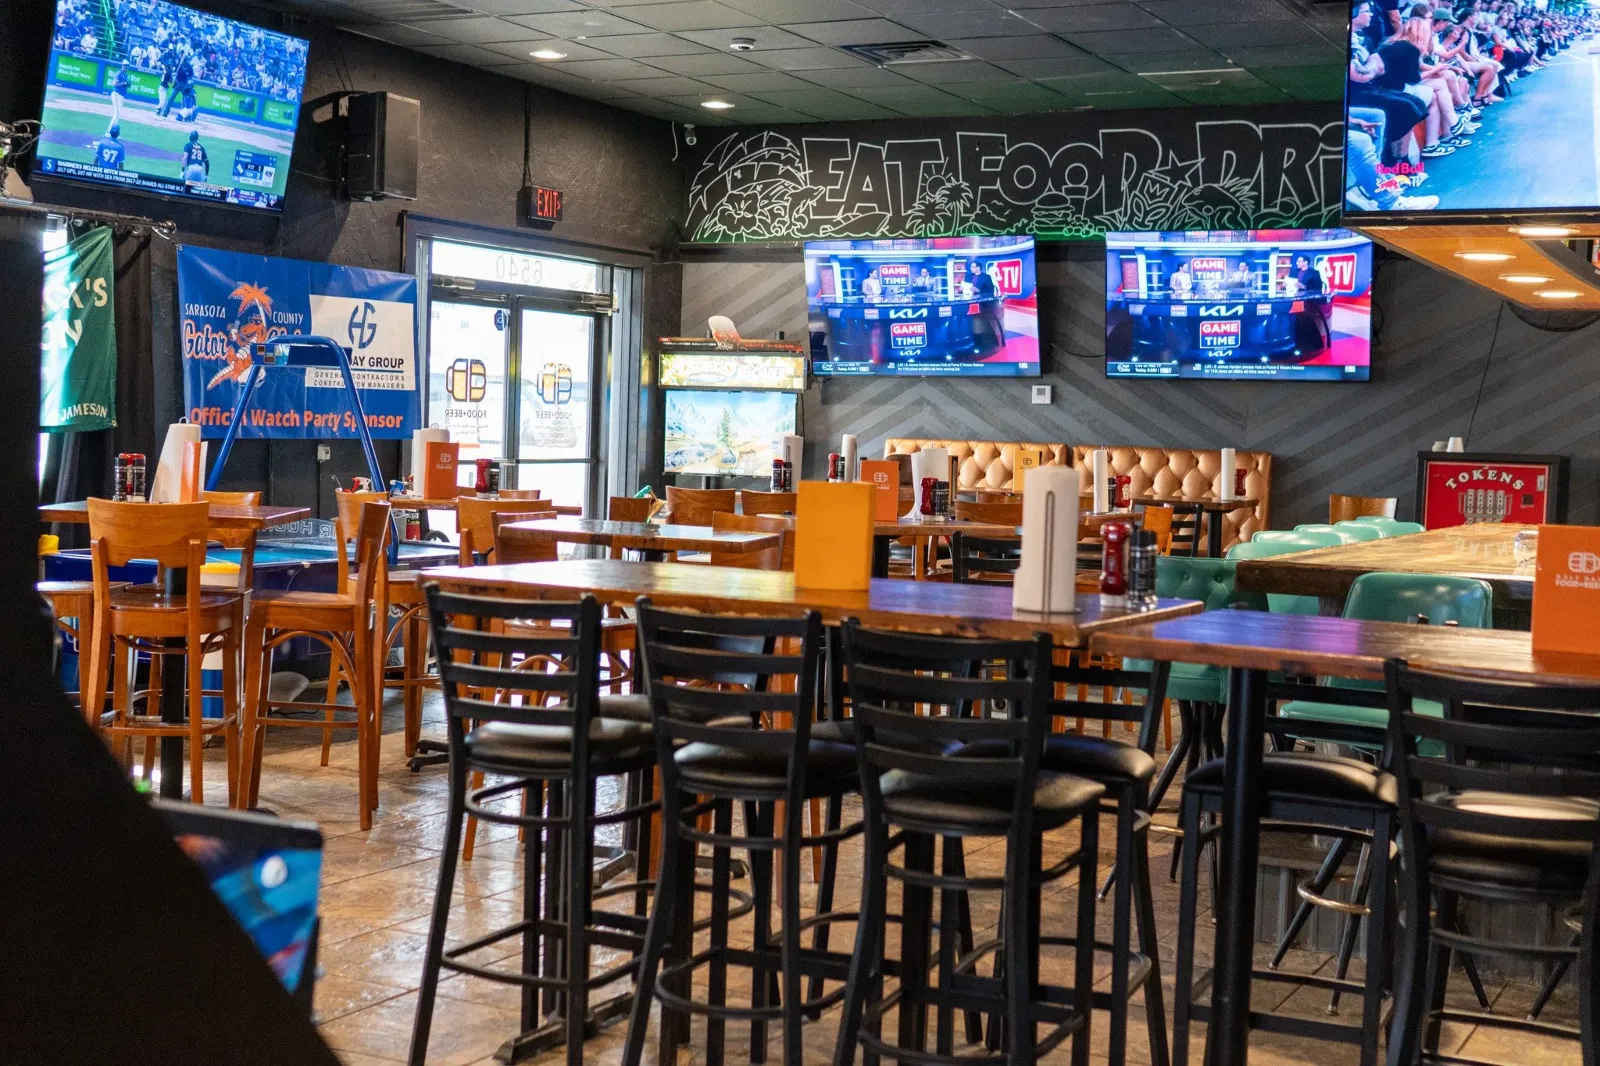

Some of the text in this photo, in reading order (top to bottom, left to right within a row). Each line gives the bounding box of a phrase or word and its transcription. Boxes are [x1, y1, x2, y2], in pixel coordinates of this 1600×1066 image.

[103, 149, 118, 164] 97
[802, 138, 944, 218] EAT
[956, 129, 1163, 217] FOOD
[1376, 162, 1424, 174] Red Bull
[536, 188, 558, 218] EXIT
[882, 266, 908, 275] GAME
[1193, 260, 1224, 269] GAME
[1002, 266, 1020, 289] TV
[1196, 271, 1222, 280] TIME
[1333, 261, 1352, 285] TV
[884, 276, 906, 286] TIME
[185, 303, 304, 325] SARASOTA COUNTY
[893, 324, 924, 334] GAME
[1202, 323, 1238, 334] GAME
[183, 319, 229, 361] Gator
[896, 336, 923, 346] TIME
[1204, 336, 1236, 346] TIME
[368, 356, 404, 369] GROUP
[368, 381, 405, 390] MANAGERS
[61, 402, 108, 421] JAMESON
[251, 409, 300, 427] Watch
[304, 410, 342, 432] Party
[344, 411, 404, 432] Spnsor
[1445, 468, 1525, 491] TOKENS
